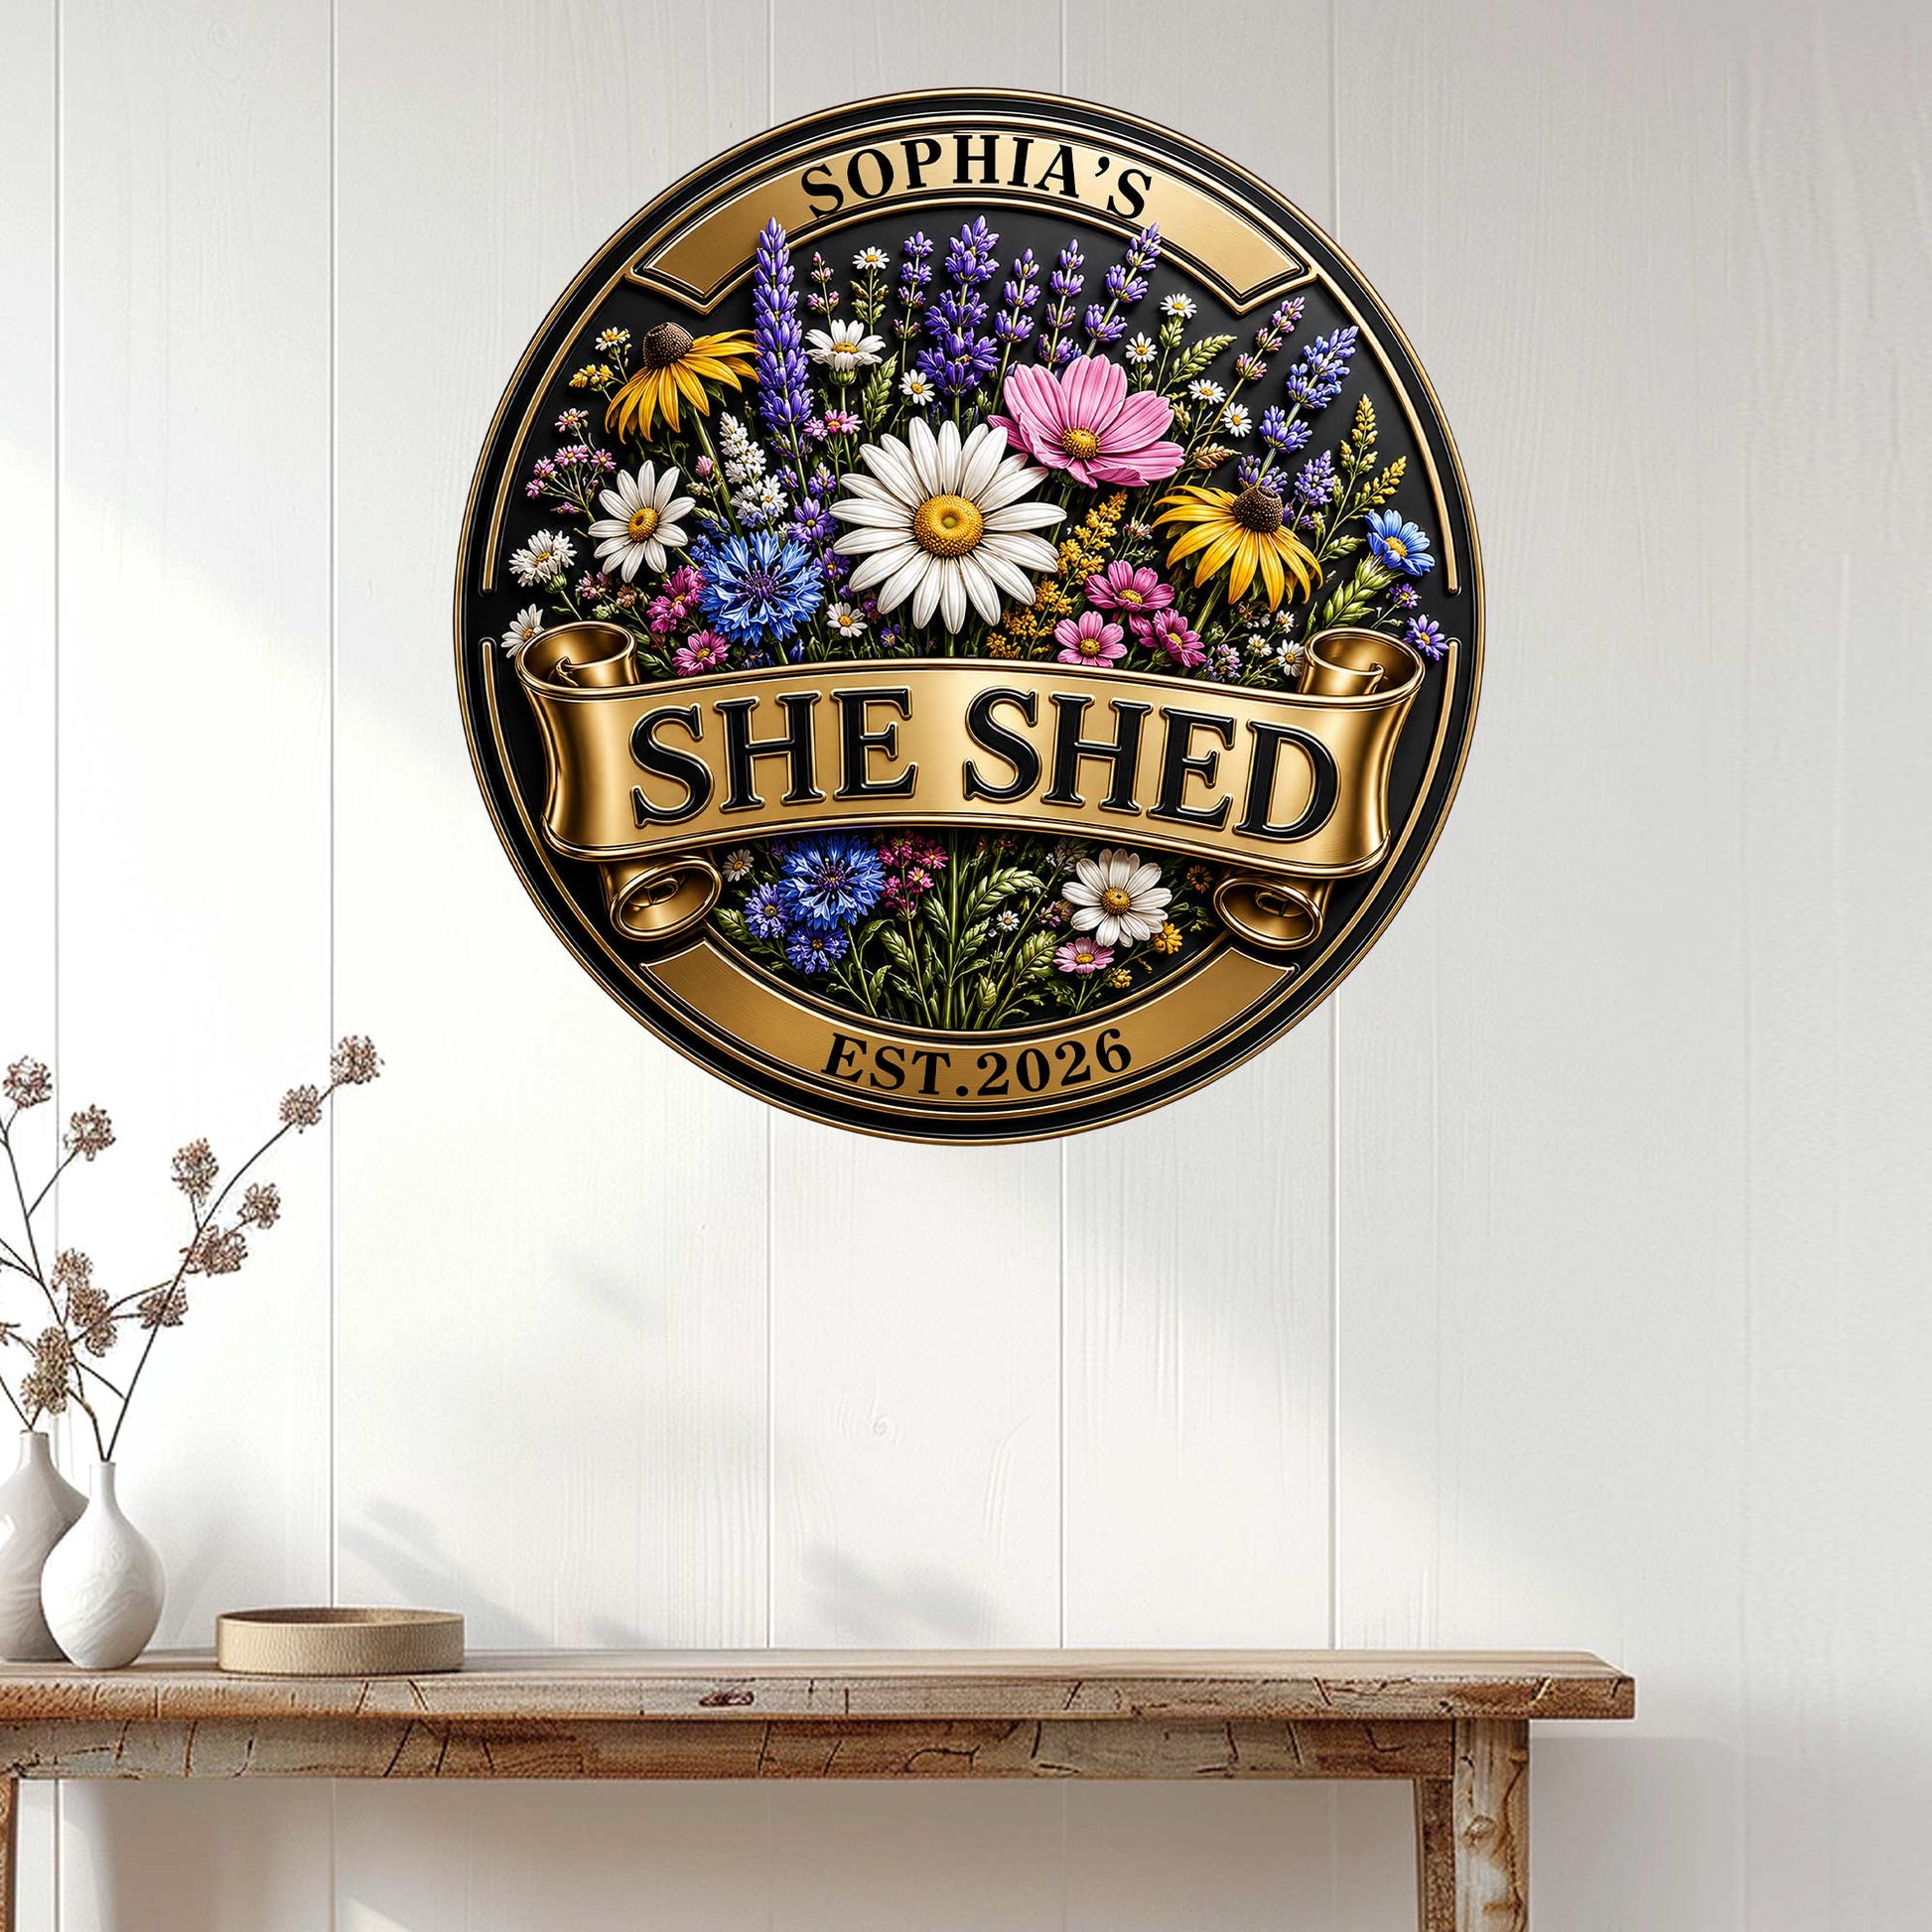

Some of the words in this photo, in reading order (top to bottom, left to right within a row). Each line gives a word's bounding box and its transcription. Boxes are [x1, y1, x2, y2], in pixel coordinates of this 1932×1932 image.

[800, 134, 1153, 219] SOPHIA'S
[629, 686, 918, 828] SHE
[963, 686, 1340, 842] SHED
